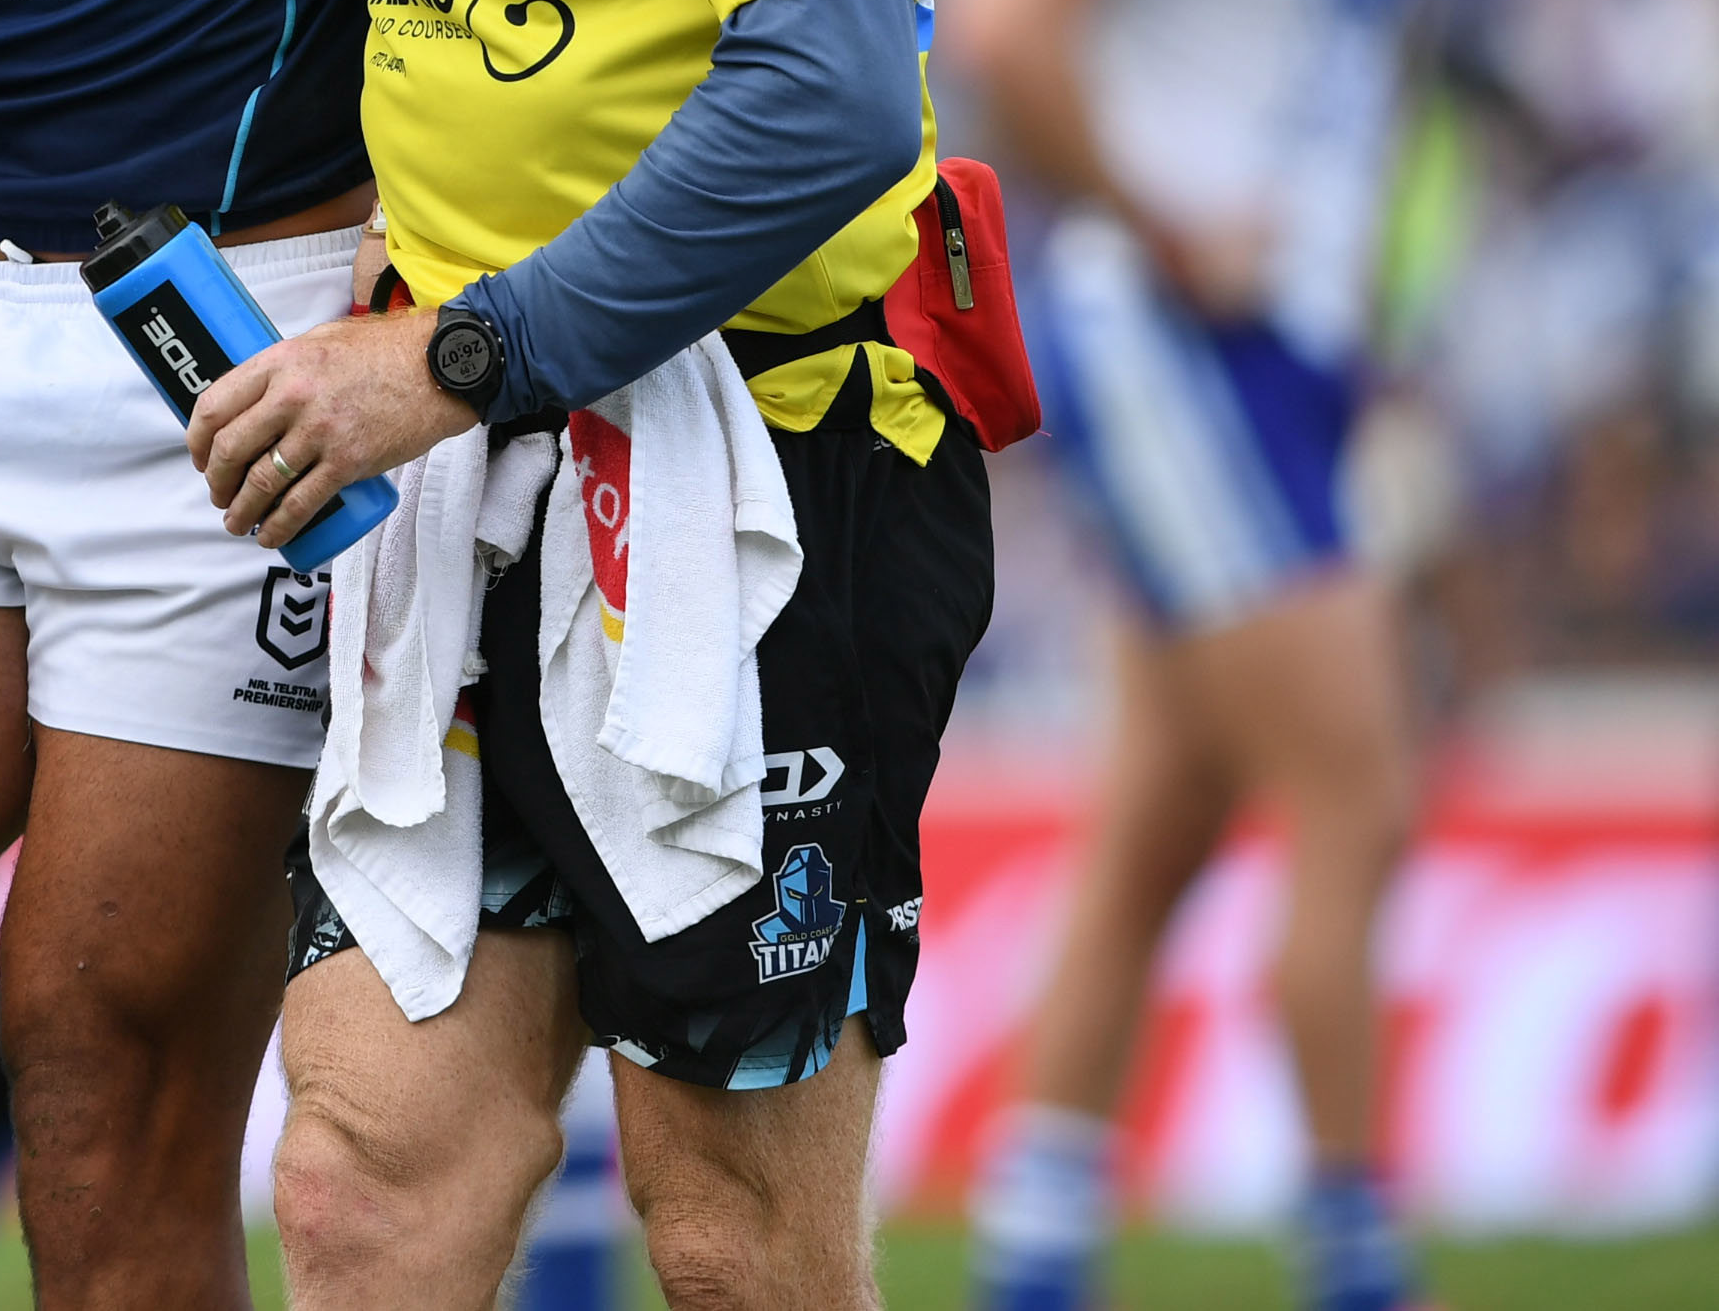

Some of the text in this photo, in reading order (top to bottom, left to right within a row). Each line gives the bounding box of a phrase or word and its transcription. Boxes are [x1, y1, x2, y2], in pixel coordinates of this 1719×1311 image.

[397, 19, 473, 40] COURSES
[442, 339, 483, 369] 26:07
[247, 678, 318, 698] NRL TELSTRA
[233, 688, 323, 713] PREMIERSHIP
[780, 932, 808, 943] GOLD
[757, 937, 834, 976] TITAN
